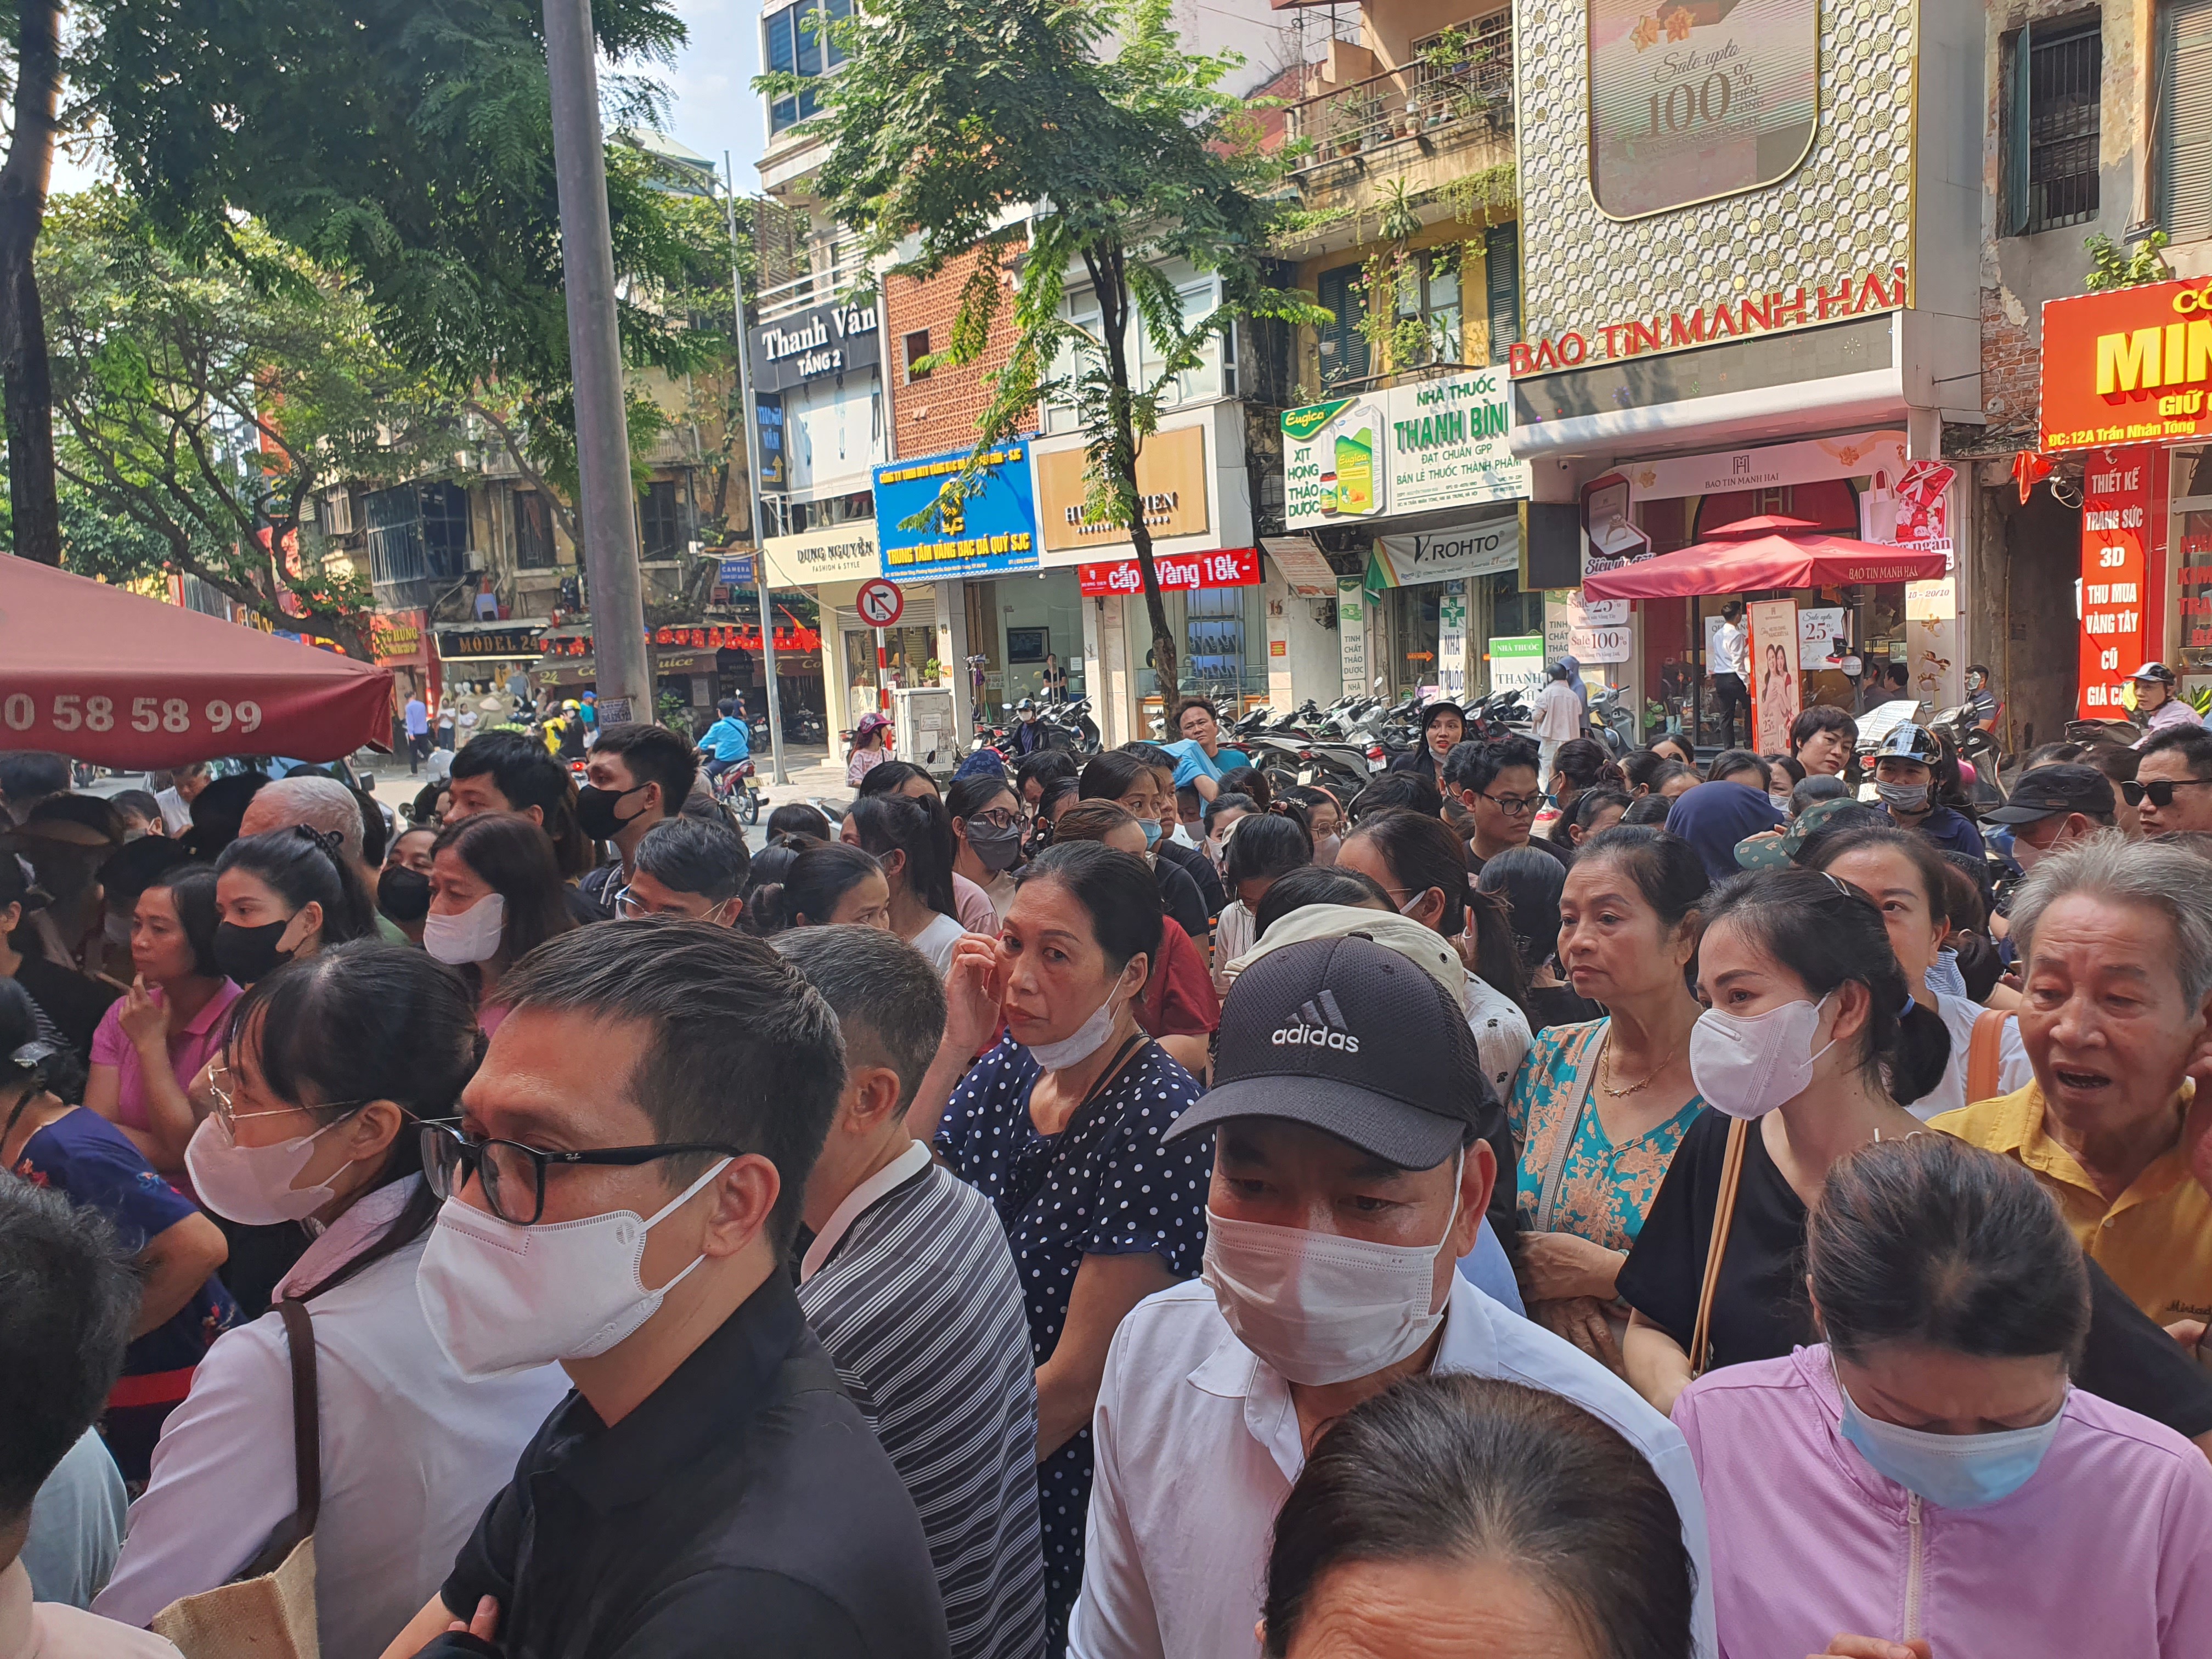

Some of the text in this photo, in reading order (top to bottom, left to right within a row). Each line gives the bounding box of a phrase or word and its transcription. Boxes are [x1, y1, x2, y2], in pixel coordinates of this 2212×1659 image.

[1655, 38, 1740, 82] Sale upto
[761, 301, 877, 360] Thanh Vân
[832, 349, 841, 367] 2
[1449, 373, 1497, 400] THUỐC
[2159, 389, 2204, 416] GIỮ
[1285, 410, 1324, 427] Eugica
[1394, 410, 1465, 450] THANH
[2127, 422, 2161, 438] Nhân
[2164, 420, 2196, 434] Tông
[1008, 448, 1022, 461] SJC
[1338, 454, 1367, 466] Eugica
[1421, 452, 1439, 466] ĐẠT
[1475, 443, 1492, 455] GPP
[1288, 463, 1319, 482] HỌNG
[1397, 471, 1413, 486] BÁN
[1429, 463, 1458, 481] THUỐC
[1461, 458, 1492, 475] THÀNH
[1705, 472, 1779, 489] BAO TIN MANH HAI
[2092, 466, 2141, 494] THIẾT KẾ
[1288, 481, 1319, 501] THẢO
[1140, 491, 1175, 511] IEN
[1289, 500, 1321, 517] DƯỢC
[2086, 504, 2143, 532] TRANG SỨC
[887, 532, 1030, 565] TRUNG TÂM VÀNG BẠC ĐÁ QUÝ SJC
[1913, 535, 1951, 552] ngàn
[1585, 556, 1611, 575] Siêu
[2100, 546, 2125, 568] 3D
[812, 563, 836, 573] FASHION
[843, 561, 860, 569] STYLE
[1109, 562, 1140, 593] cấp
[1154, 560, 1200, 589] Vàng
[1204, 554, 1240, 581] 18k
[1849, 567, 1864, 580] BAO
[1866, 567, 1879, 579] TIN
[1880, 566, 1903, 579] MANH
[1925, 589, 1950, 597] 20/10
[2087, 583, 2137, 605] THU MUA
[1549, 620, 1568, 629] TINH
[2086, 609, 2139, 635] VÀNG TÂY
[1344, 635, 1361, 643] TINH
[1571, 631, 1627, 649] Sale 100%
[1805, 623, 1834, 641] 25%
[459, 634, 517, 653] MODEL
[1344, 643, 1362, 653] CHẤT
[1444, 630, 1460, 656] NHÀ
[1498, 644, 1513, 652] NHÀ
[658, 657, 694, 668] uice
[1344, 654, 1363, 664] THẢO
[2101, 647, 2118, 670] CŨ
[1344, 666, 1364, 675] DƯỢC
[1497, 673, 1541, 685] THANH
[2087, 682, 2108, 707] GIÁ
[53, 695, 114, 732] 58
[132, 697, 190, 733] 58
[205, 699, 262, 733] 99
[1271, 1023, 1359, 1053] adidas
